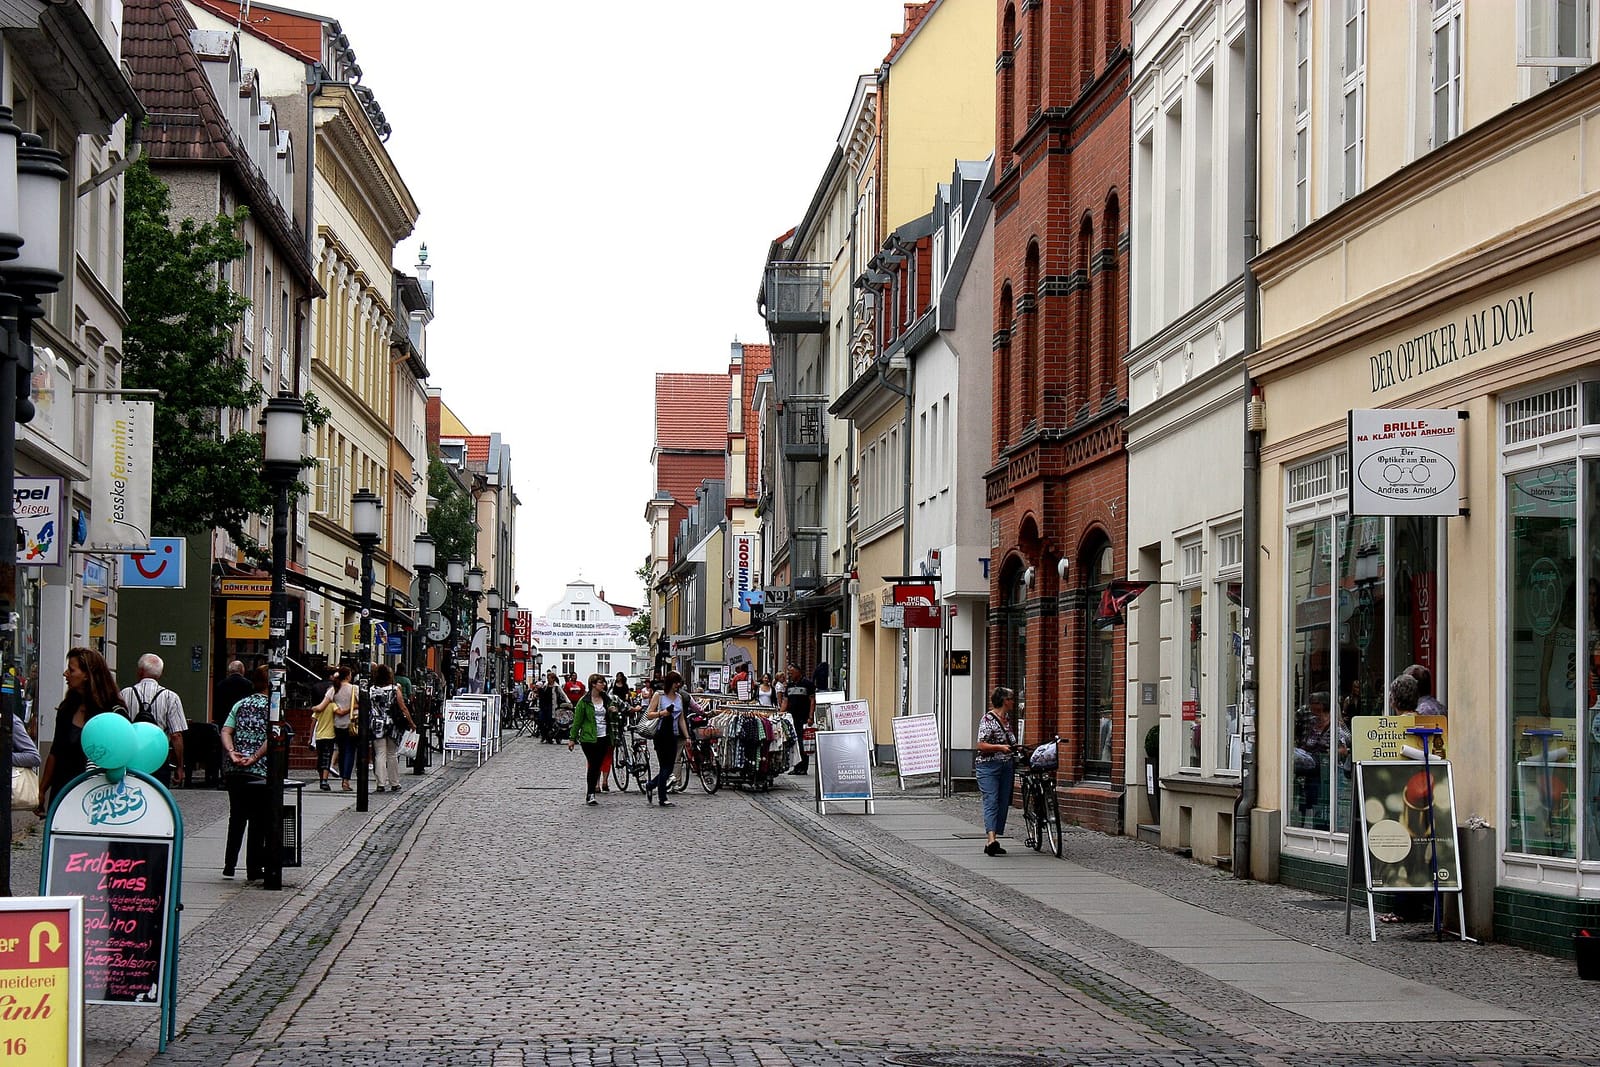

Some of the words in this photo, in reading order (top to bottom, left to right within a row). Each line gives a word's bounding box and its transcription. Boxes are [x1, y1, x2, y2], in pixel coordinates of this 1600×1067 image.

[1370, 354, 1396, 393] DER
[1397, 323, 1459, 383] OPTIKER
[1462, 310, 1487, 359] AM
[1492, 291, 1535, 347] DOM
[1383, 420, 1428, 432] BRILLE-
[1421, 427, 1455, 436] ARNOLD!
[1400, 448, 1414, 457] Der
[1377, 456, 1404, 464] Optiker
[1419, 455, 1437, 464] Dom
[1413, 486, 1437, 494] Arnold
[1418, 572, 1430, 666] ESPRIT
[1378, 718, 1398, 729] Der
[1367, 729, 1408, 741] Optiker
[1372, 747, 1397, 758] Dom
[88, 786, 144, 826] FASS
[65, 852, 146, 874] Erdbeer
[96, 876, 147, 891] Limes
[0, 975, 56, 989] neiderei
[4, 1038, 27, 1056] 16
